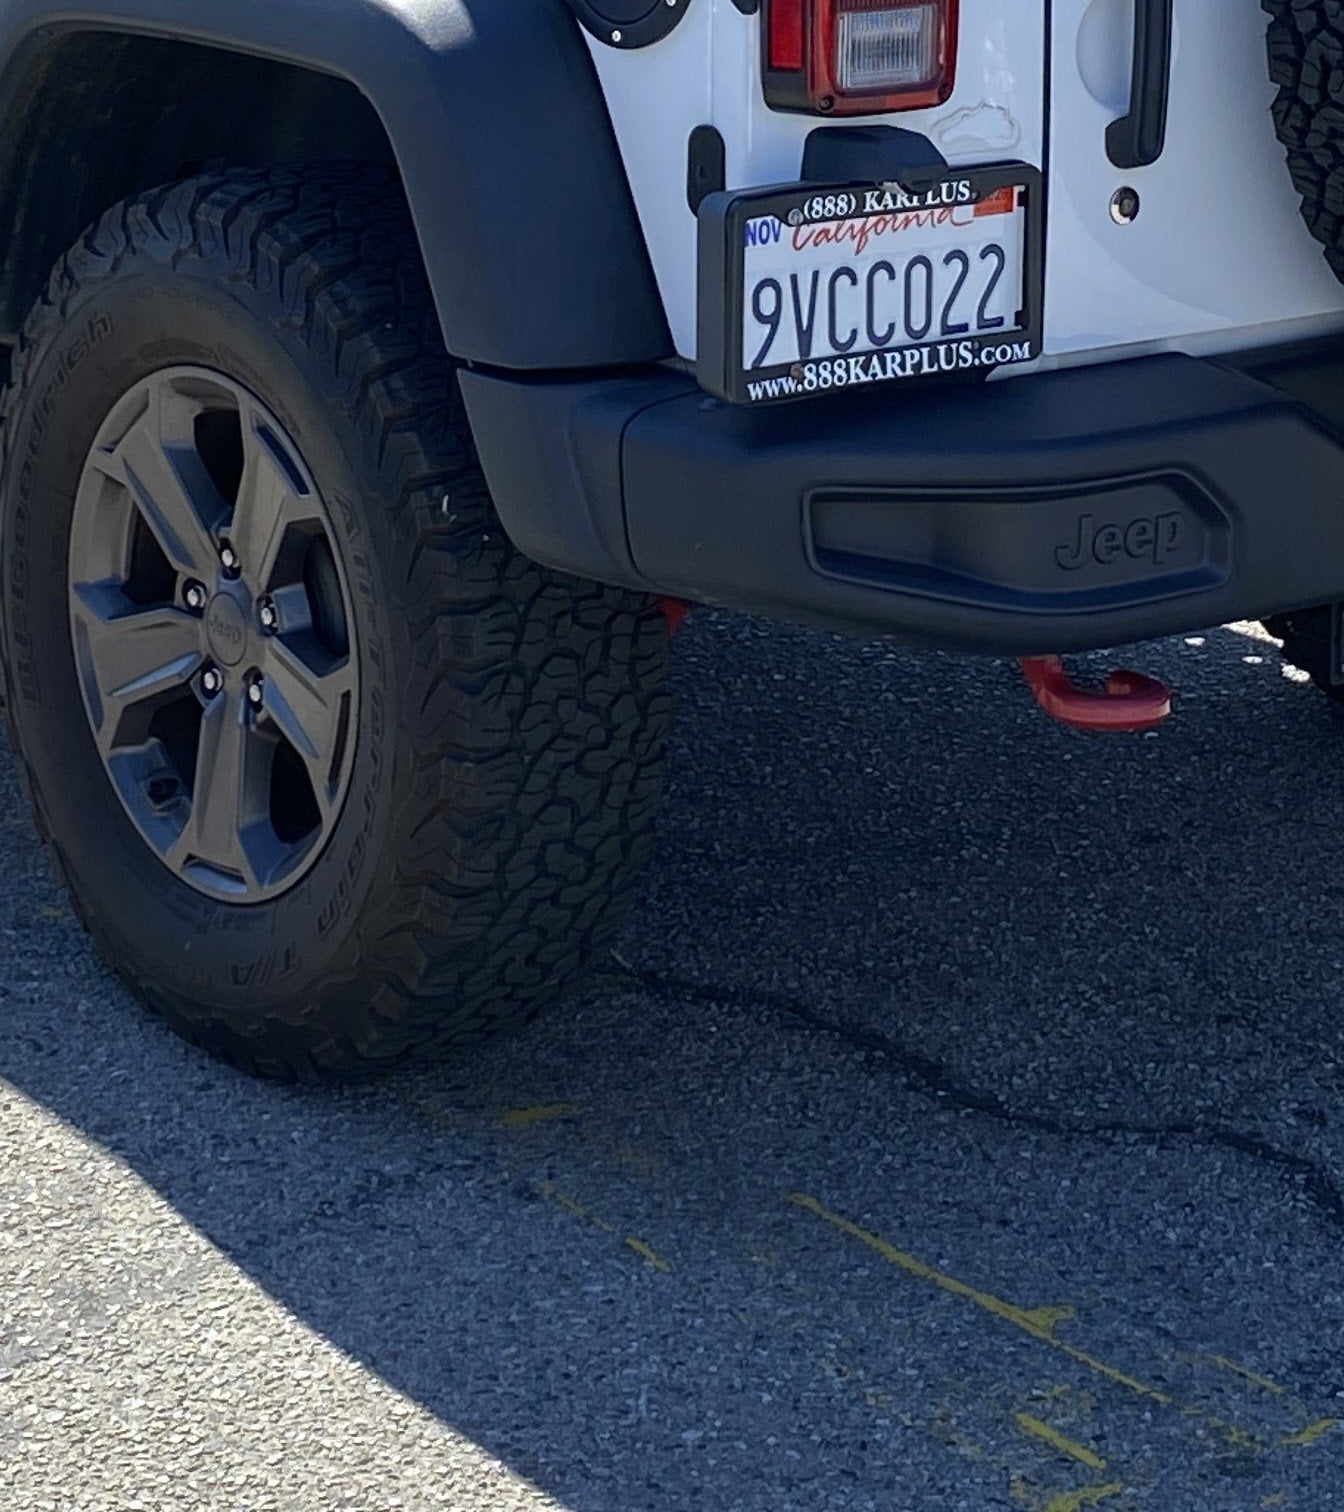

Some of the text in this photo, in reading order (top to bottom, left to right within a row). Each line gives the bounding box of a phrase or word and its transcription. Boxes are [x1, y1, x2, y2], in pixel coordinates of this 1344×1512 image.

[745, 206, 974, 256] NOV California
[804, 194, 856, 219] (888)
[752, 243, 1006, 369] 9VCC022
[1056, 510, 1184, 571] Jeep
